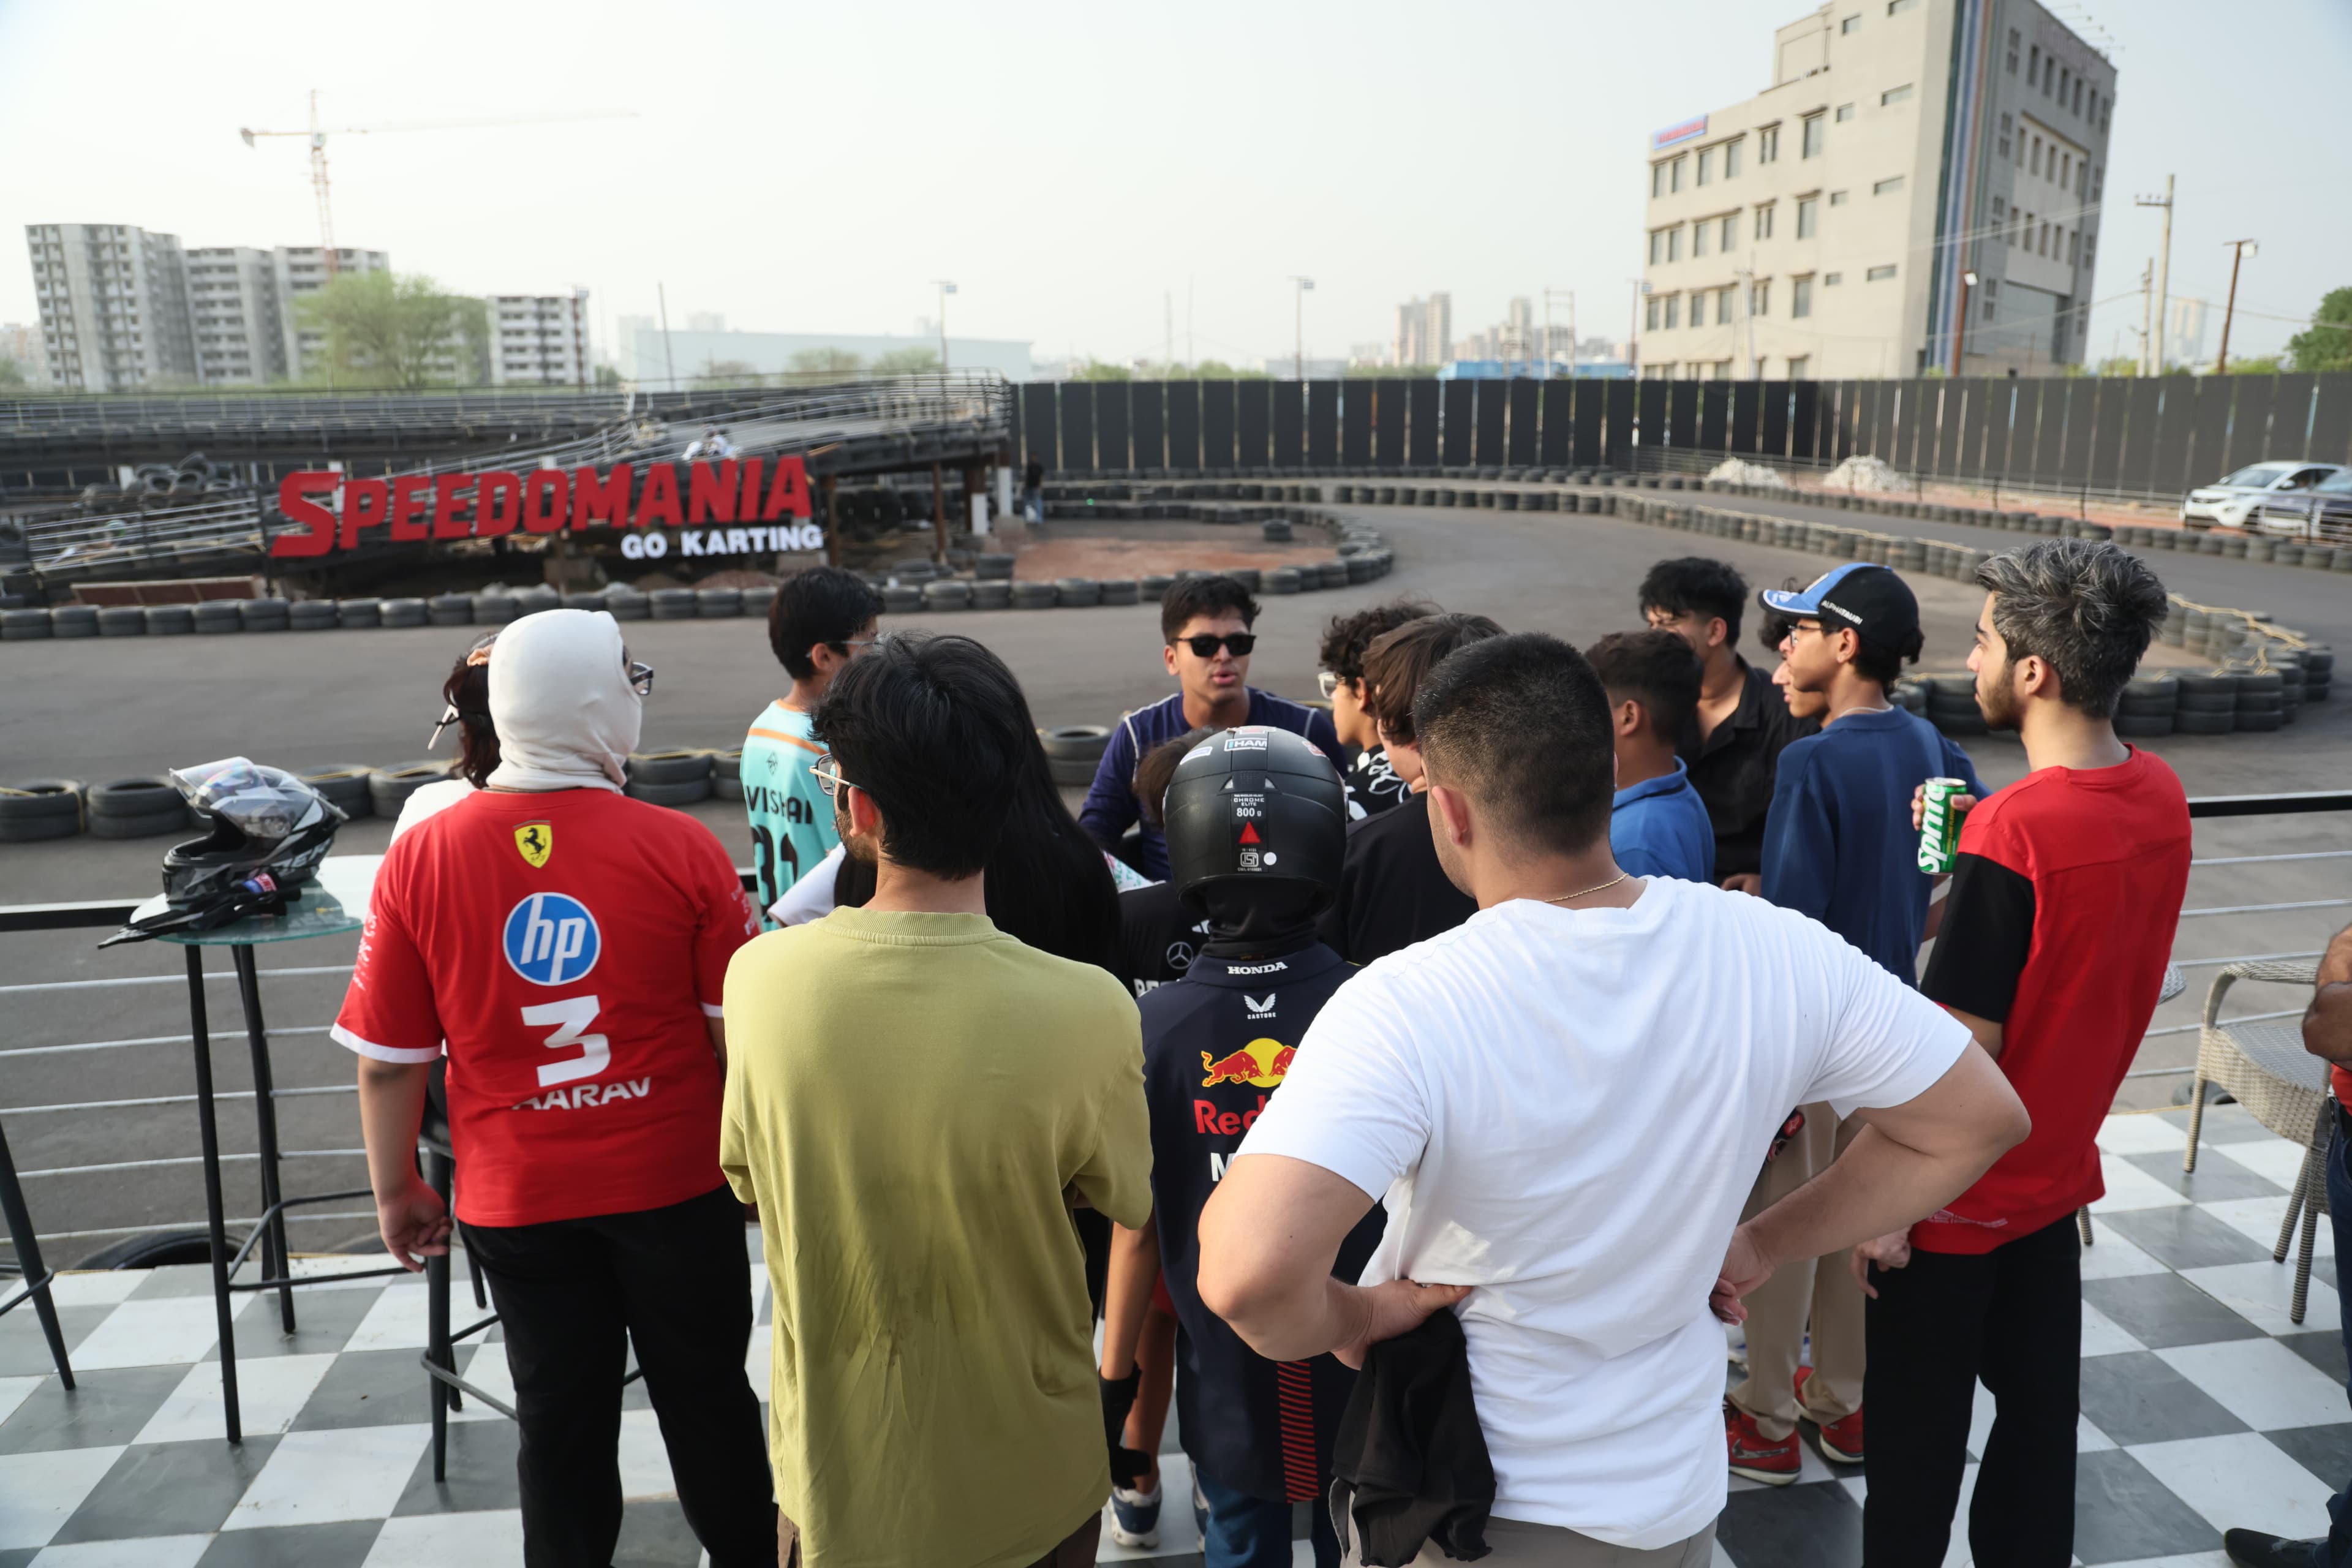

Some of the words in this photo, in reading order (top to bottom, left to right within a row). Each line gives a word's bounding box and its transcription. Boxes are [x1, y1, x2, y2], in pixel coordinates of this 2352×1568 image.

[270, 455, 813, 558] SPEEDOMANIA
[620, 532, 668, 560] GO
[680, 524, 824, 557] KARTING
[1821, 600, 1863, 625] ALPHATAURI
[1237, 807, 1255, 817] 800
[1918, 783, 1948, 873] Sprite
[520, 892, 587, 982] hp
[1227, 962, 1288, 974] HONDA
[520, 995, 611, 1088] 3
[511, 1076, 651, 1110] AARAV
